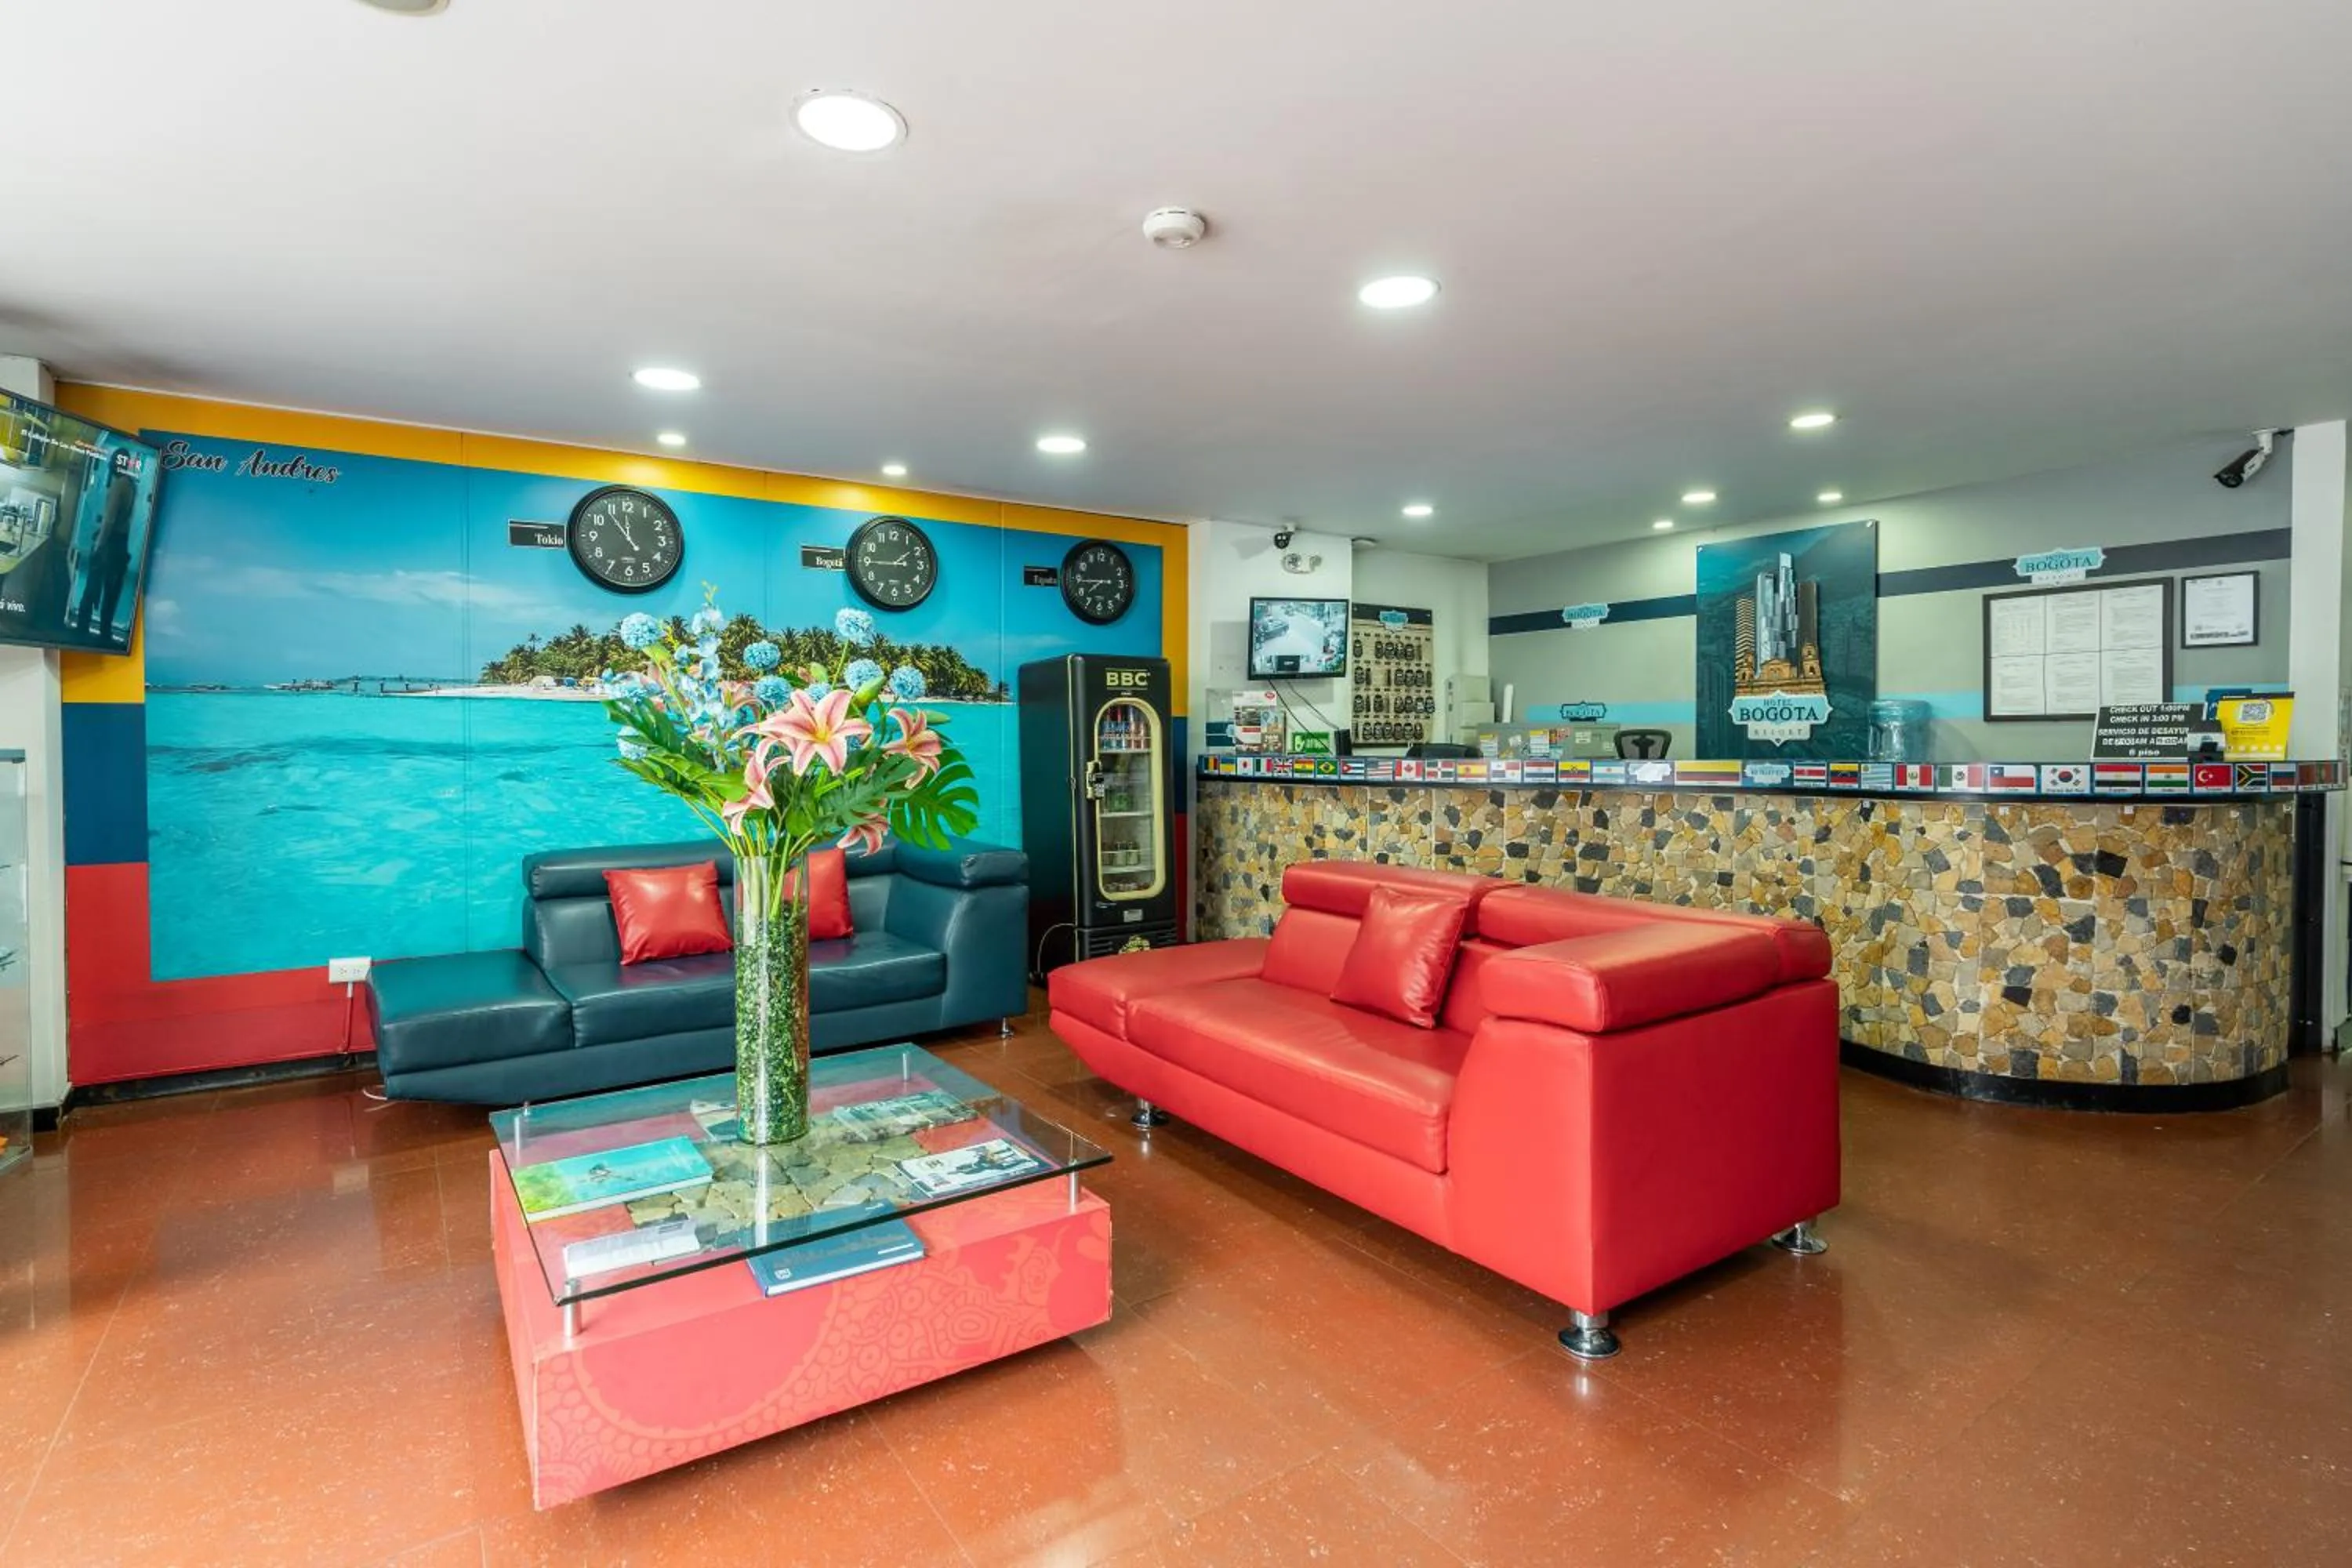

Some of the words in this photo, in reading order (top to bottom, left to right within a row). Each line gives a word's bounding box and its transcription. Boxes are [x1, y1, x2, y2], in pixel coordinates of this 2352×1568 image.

[162, 440, 227, 472] San
[236, 448, 339, 483] Andres
[608, 503, 615, 515] 11
[622, 501, 634, 514] 12
[593, 514, 604, 525] 10
[653, 520, 662, 531] 2
[534, 532, 564, 545] Tokio
[589, 531, 598, 542] 9
[658, 535, 666, 546] 3
[877, 533, 885, 543] 11
[888, 531, 899, 541] 12
[595, 546, 603, 557] 8
[867, 543, 876, 553] 10
[914, 547, 921, 556] 2
[652, 551, 661, 562] 4
[863, 557, 871, 567] 9
[607, 559, 615, 572] 7
[625, 565, 633, 576] 6
[642, 562, 650, 573] 5
[916, 561, 924, 570] 3
[2025, 557, 2092, 573] BOGOTA
[868, 571, 875, 581] 8
[912, 574, 920, 583] 4
[877, 583, 884, 592] 7
[891, 587, 898, 596] 6
[904, 584, 912, 593] 5
[1106, 672, 1148, 686] BBC
[1740, 706, 1819, 721] BOGOTA
[2140, 705, 2158, 713] OUT
[2110, 715, 2138, 724] CHECK
[2140, 714, 2151, 723] IN
